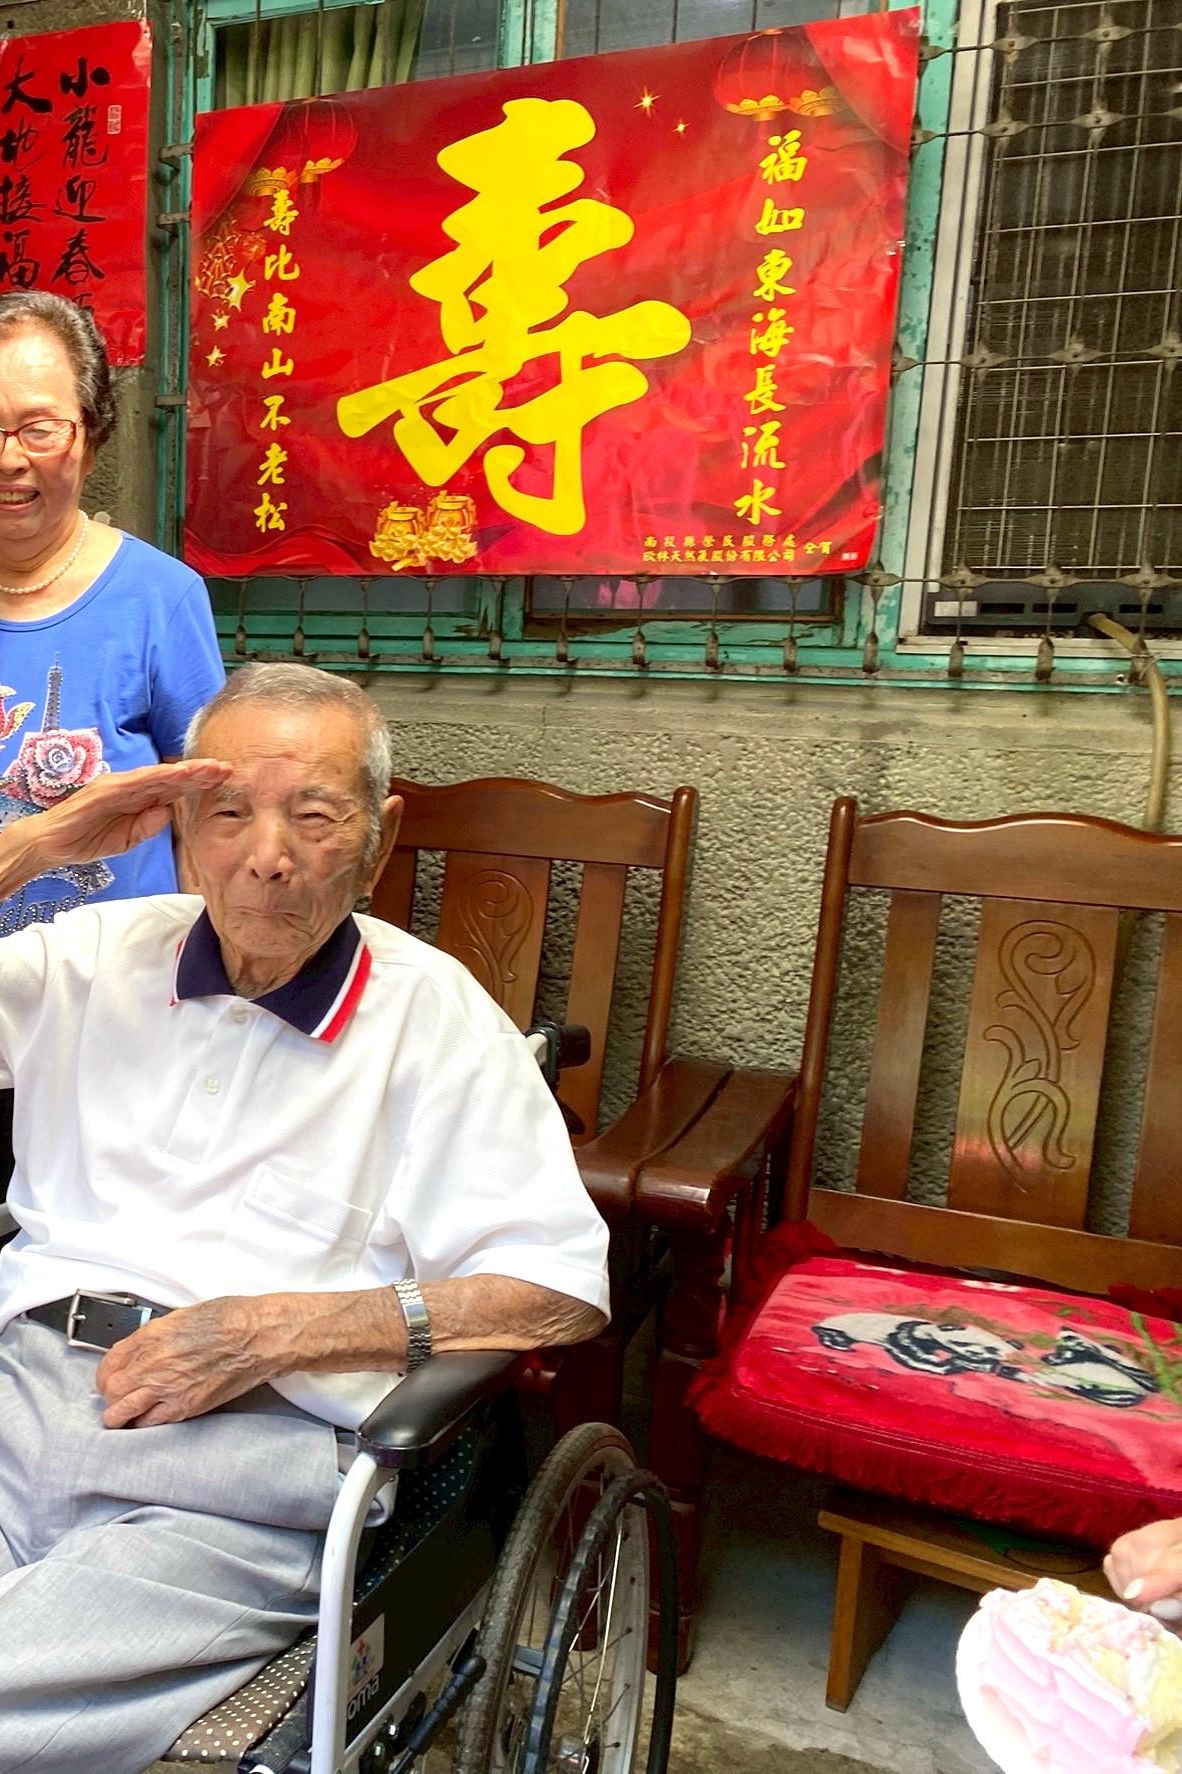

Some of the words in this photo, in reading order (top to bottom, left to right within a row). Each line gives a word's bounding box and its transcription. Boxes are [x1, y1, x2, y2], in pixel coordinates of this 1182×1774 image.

[253, 189, 301, 533] 壽比南山不老松
[733, 129, 809, 526] 福如東海長流水
